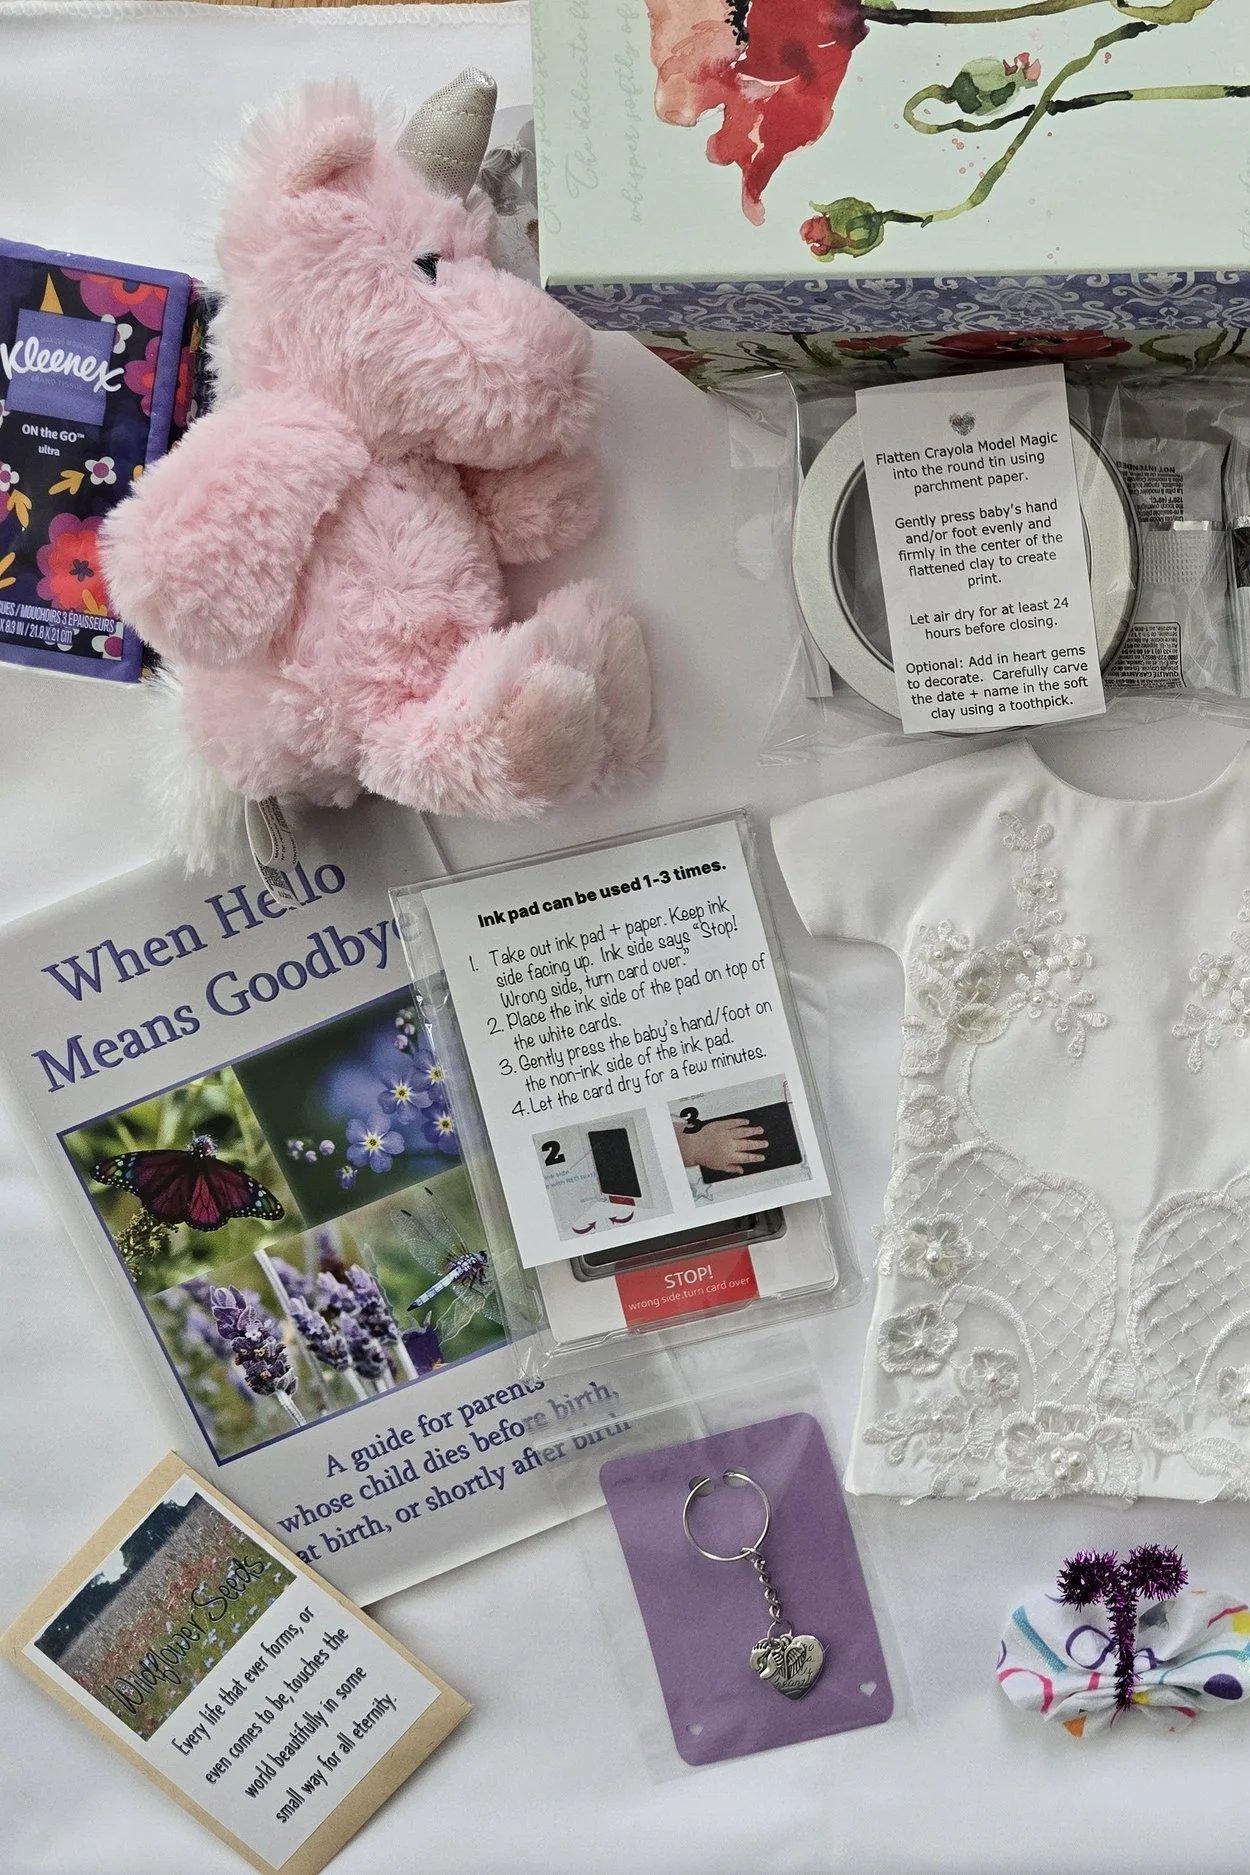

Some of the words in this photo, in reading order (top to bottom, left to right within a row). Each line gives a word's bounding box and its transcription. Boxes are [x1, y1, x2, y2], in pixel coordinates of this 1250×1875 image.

[0, 336, 124, 393] Kleenex
[22, 424, 39, 436] ON
[40, 426, 58, 439] the
[38, 444, 60, 456] ultra
[875, 451, 920, 465] Flatten
[924, 442, 973, 459] Crayola
[977, 435, 1015, 452] Model
[1019, 431, 1058, 447] Magic
[892, 467, 918, 480] into
[921, 463, 943, 476] the
[947, 456, 984, 473] round
[988, 455, 1005, 467] tin
[1010, 451, 1044, 465] using
[913, 475, 983, 497] parchment
[987, 471, 1028, 487] paper.
[894, 513, 936, 529] Gently
[940, 511, 975, 526] press
[1025, 497, 1057, 513] hand
[905, 529, 948, 544] and/or
[951, 525, 978, 538] foot
[981, 519, 1023, 535] evenly
[1028, 515, 1051, 529] and
[20, 604, 61, 624] MOUCHOIRS
[62, 612, 67, 625] 3
[68, 610, 115, 633] ÉPAISSEURS
[905, 657, 963, 675] Optional:
[968, 653, 993, 667] Add
[996, 652, 1008, 664] in
[1012, 648, 1047, 662] heart
[1050, 646, 1085, 661] gems
[930, 707, 955, 720] clay
[960, 703, 993, 716] using
[998, 703, 1006, 712] a
[1009, 694, 1073, 710] toothpick.
[477, 910, 506, 928] Ink
[507, 900, 540, 924] pad
[542, 896, 574, 912] can
[573, 890, 597, 904] be
[598, 876, 642, 898] used
[642, 870, 671, 888] 1-3
[672, 860, 726, 880] times.
[488, 945, 526, 966] Take
[530, 939, 551, 957] out
[554, 931, 578, 951] ink
[579, 923, 606, 951] pad
[624, 915, 667, 940] paper.
[668, 905, 705, 924] Keep
[706, 895, 730, 914] ink
[41, 922, 208, 1001] When
[496, 967, 523, 987] side
[527, 960, 571, 980] facing
[573, 955, 594, 973] up.
[599, 943, 624, 962] Ink
[626, 938, 654, 956] side
[658, 931, 691, 949] says
[31, 1004, 201, 1092] Means
[513, 1033, 535, 1051] the
[538, 1025, 575, 1044] white
[579, 1012, 621, 1035] cards.
[557, 1089, 579, 1107] the
[582, 1078, 614, 1100] card
[617, 1074, 641, 1093] dry
[644, 1068, 664, 1085] for
[670, 1068, 679, 1079] a
[681, 1059, 707, 1076] few
[710, 1047, 767, 1069] minutes.
[679, 1106, 701, 1134] 3
[541, 1140, 566, 1167] 2
[628, 1298, 660, 1310] wrong
[706, 1281, 727, 1293] card
[728, 1277, 750, 1288] over
[664, 1265, 713, 1289] STOP!
[326, 1454, 348, 1477] A
[351, 1427, 416, 1472] guide
[417, 1414, 454, 1439] for
[457, 1377, 545, 1428] parents
[277, 1492, 355, 1533] whose
[360, 1459, 420, 1500] child
[423, 1447, 470, 1474] dies
[319, 1515, 392, 1553] birth,
[395, 1502, 422, 1523] or
[425, 1466, 505, 1512] shortly
[105, 1613, 207, 1715] Wildflower
[191, 1555, 265, 1622] Seeds
[171, 1722, 211, 1756] Every
[198, 1702, 225, 1725] life
[218, 1678, 247, 1706] that
[244, 1655, 268, 1683] ever
[260, 1623, 304, 1659] forms,
[299, 1605, 314, 1623] or
[205, 1756, 232, 1784] even
[228, 1722, 263, 1758] comes
[254, 1709, 274, 1724] to
[264, 1693, 294, 1711] be,
[283, 1648, 330, 1693] touches
[322, 1628, 349, 1650] the
[244, 1759, 277, 1798] world
[266, 1710, 329, 1768] beautifully
[319, 1698, 339, 1713] in
[335, 1666, 367, 1700] some
[275, 1786, 305, 1823] small
[300, 1768, 328, 1794] way
[316, 1750, 341, 1772] for
[336, 1731, 355, 1754] all
[352, 1693, 397, 1739] eternity.
